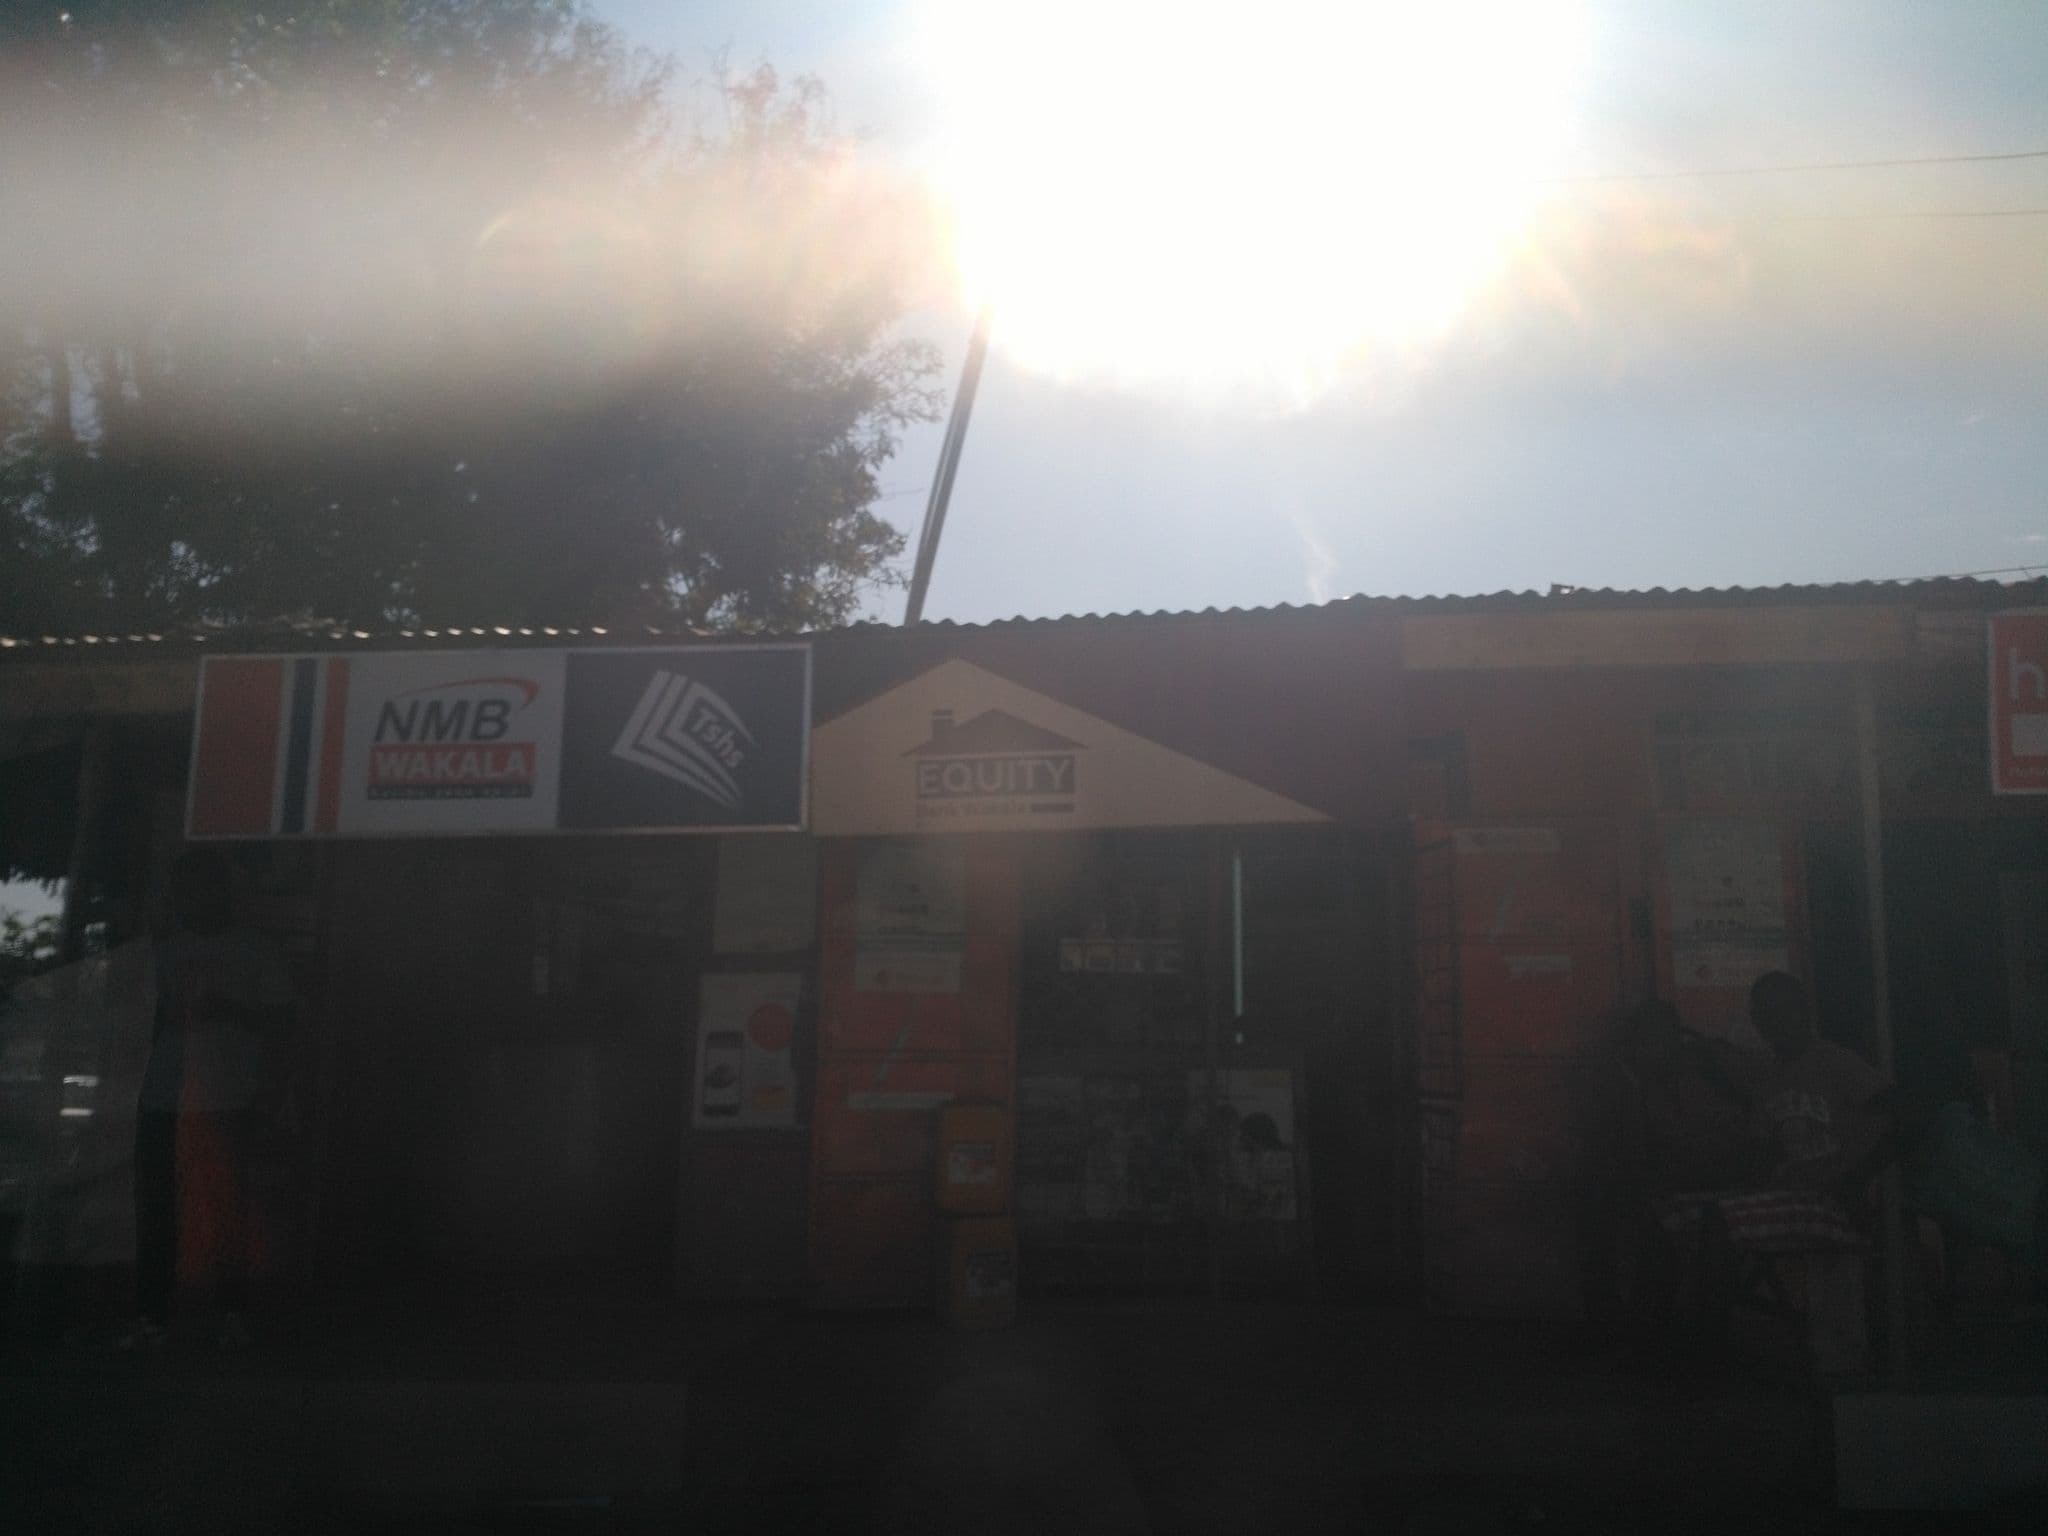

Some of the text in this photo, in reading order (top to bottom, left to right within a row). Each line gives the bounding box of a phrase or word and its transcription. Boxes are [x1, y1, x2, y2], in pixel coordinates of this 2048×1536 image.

[373, 698, 512, 742] NMB
[690, 707, 745, 769] Tshs
[375, 750, 528, 780] WAKALA
[919, 758, 1071, 795] EQUITY
